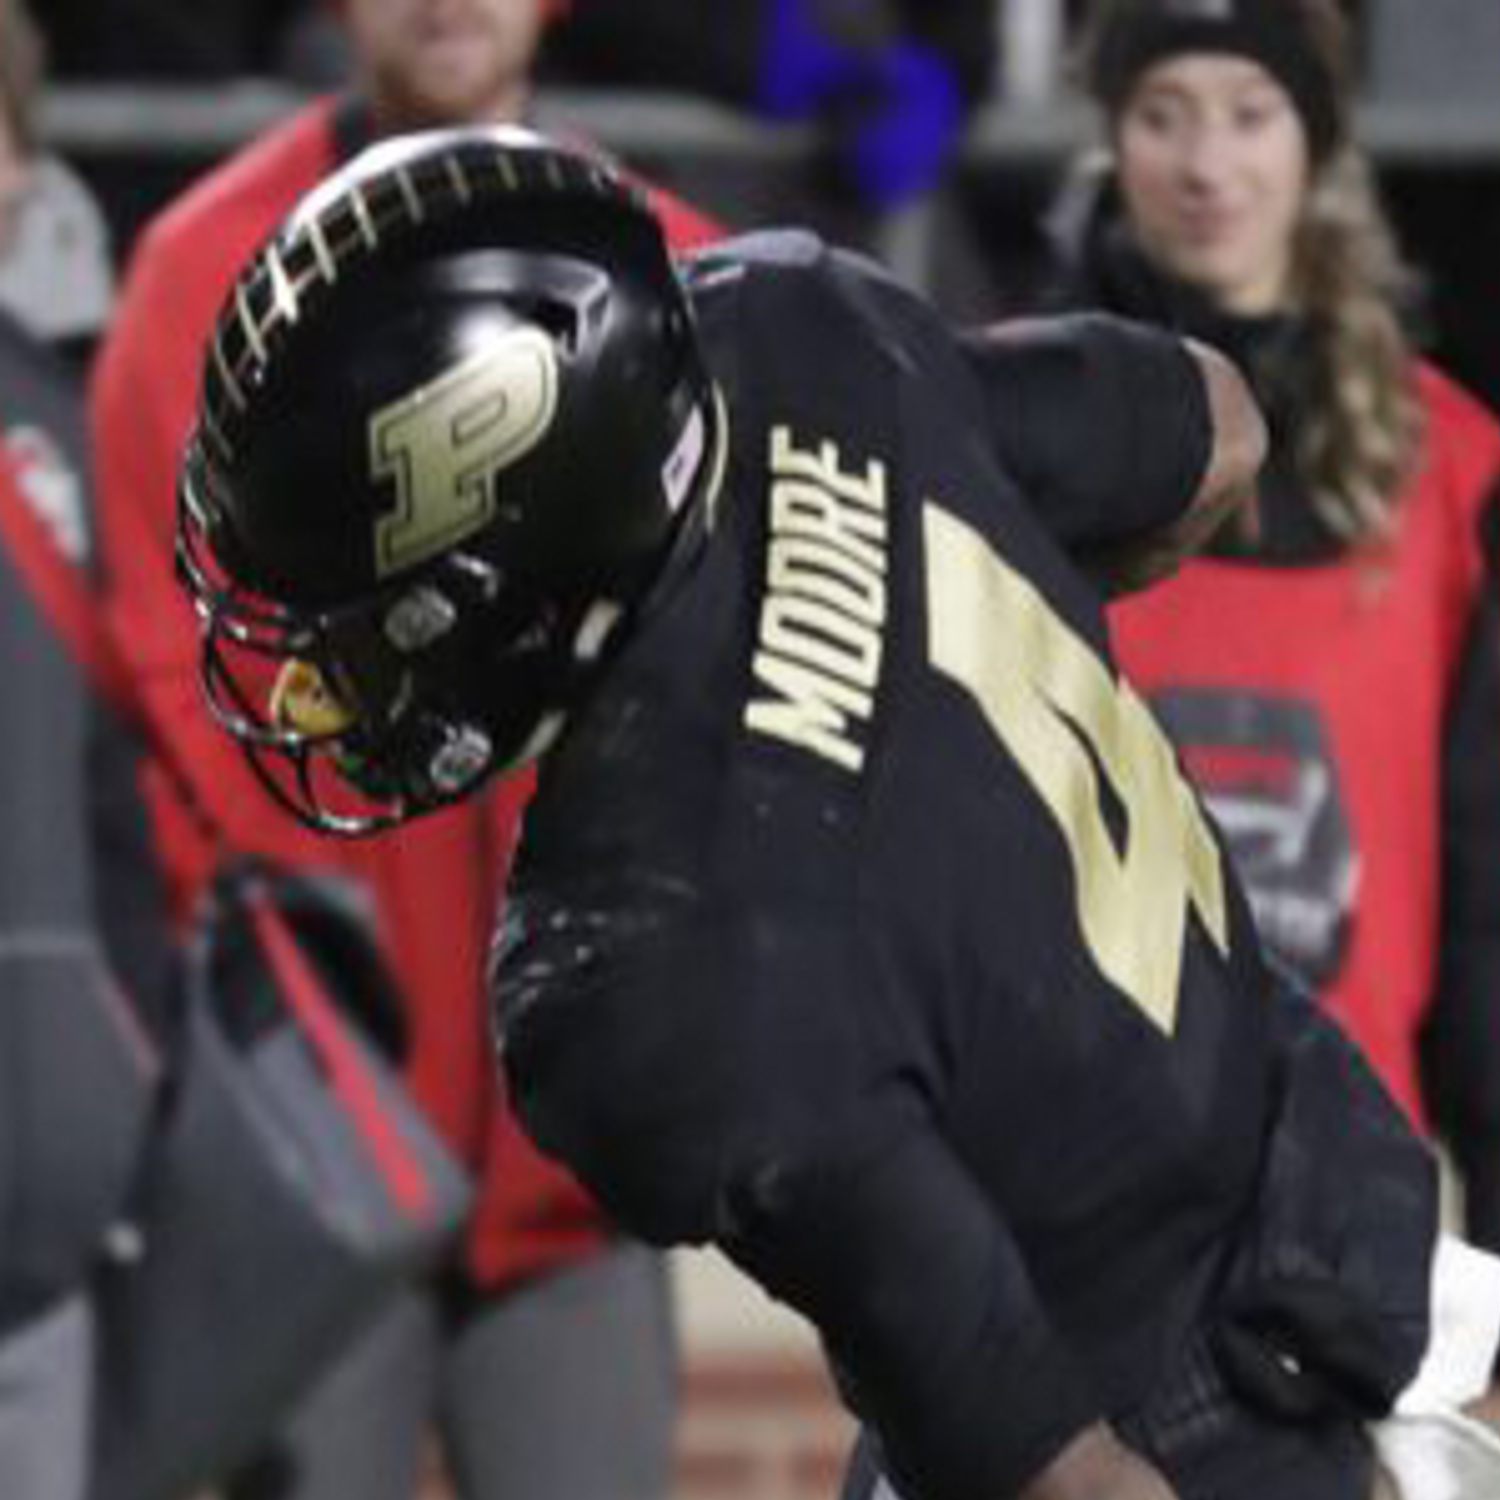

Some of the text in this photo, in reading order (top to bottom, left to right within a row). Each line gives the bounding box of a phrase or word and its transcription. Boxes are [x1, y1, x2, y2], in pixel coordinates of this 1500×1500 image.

[370, 327, 557, 577] P
[744, 425, 888, 771] MOORE
[922, 500, 1230, 1037] 4
